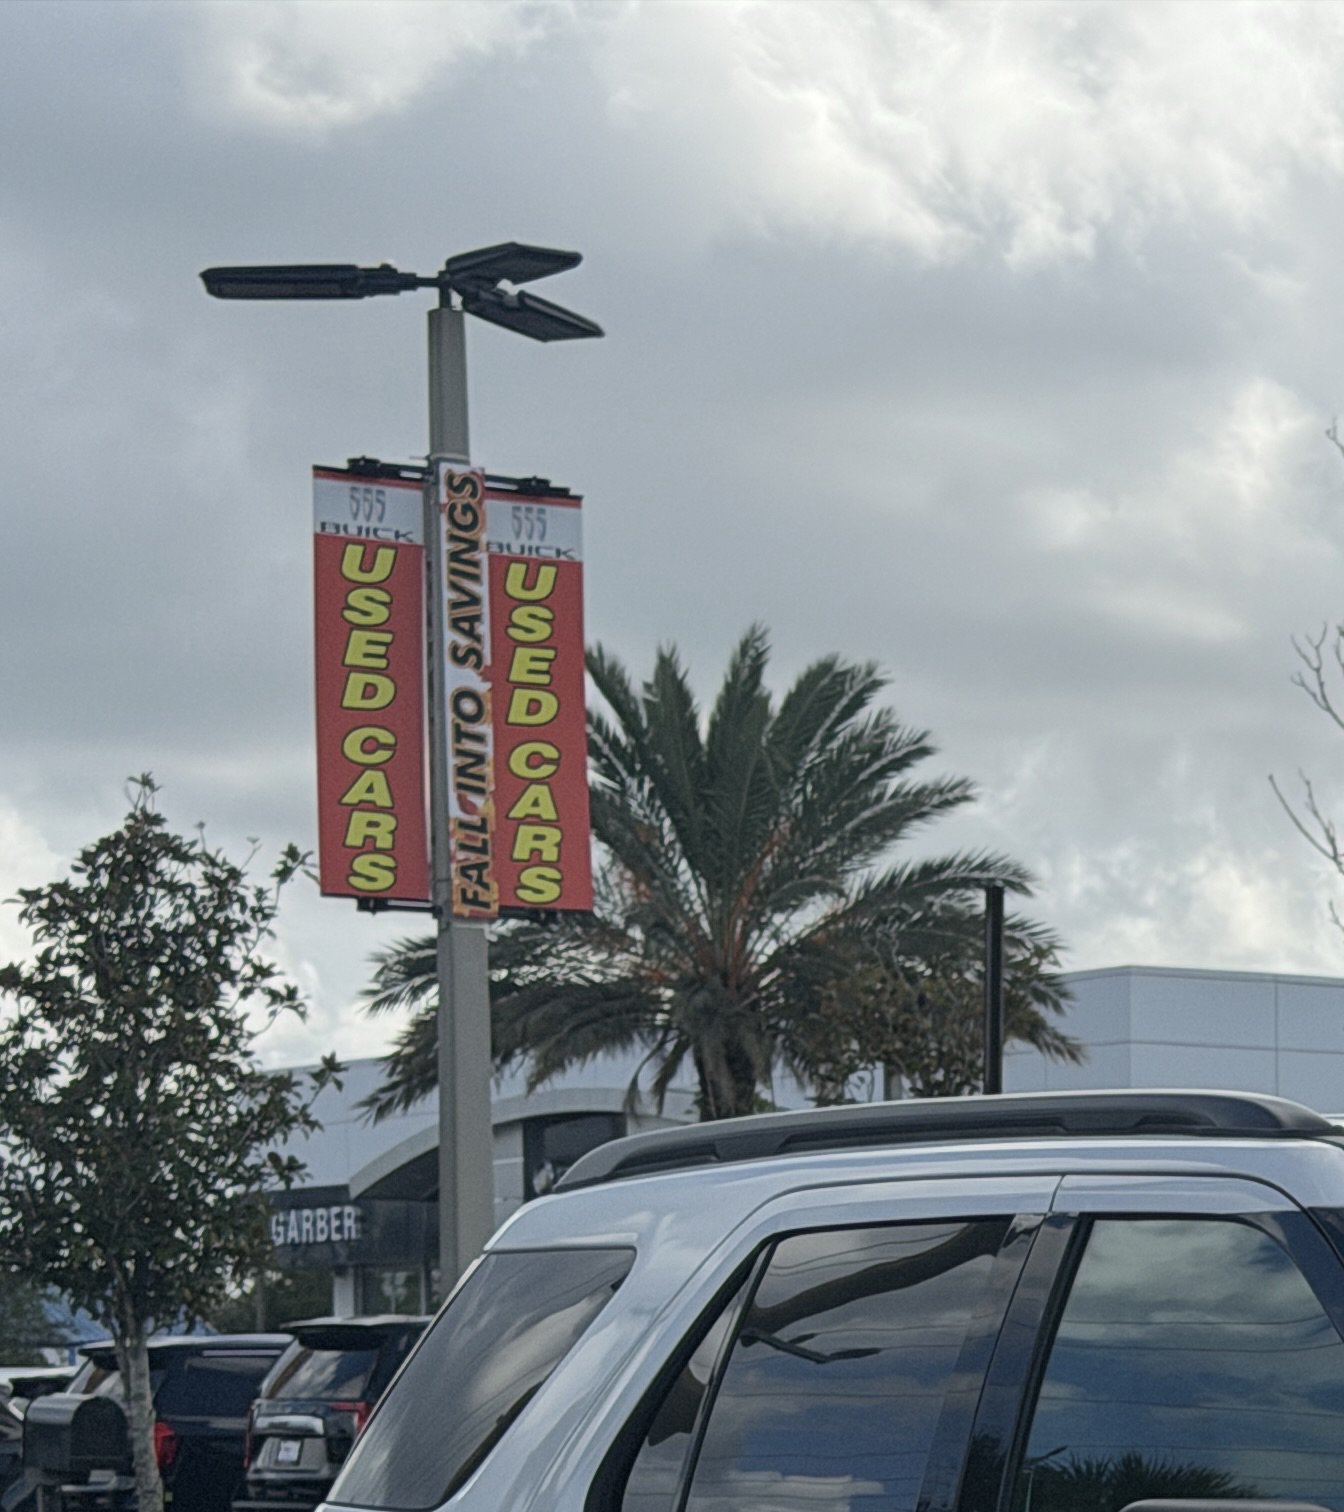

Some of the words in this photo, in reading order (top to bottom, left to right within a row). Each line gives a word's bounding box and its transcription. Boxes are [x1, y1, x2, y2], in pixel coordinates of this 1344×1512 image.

[341, 542, 398, 711] USED
[447, 469, 485, 672] SAVINGS
[505, 561, 559, 727] USED
[340, 726, 398, 893] CARS
[452, 687, 488, 797] INTO
[507, 740, 562, 905] CARS
[455, 816, 493, 911] FALL
[271, 1205, 358, 1246] GARBER
